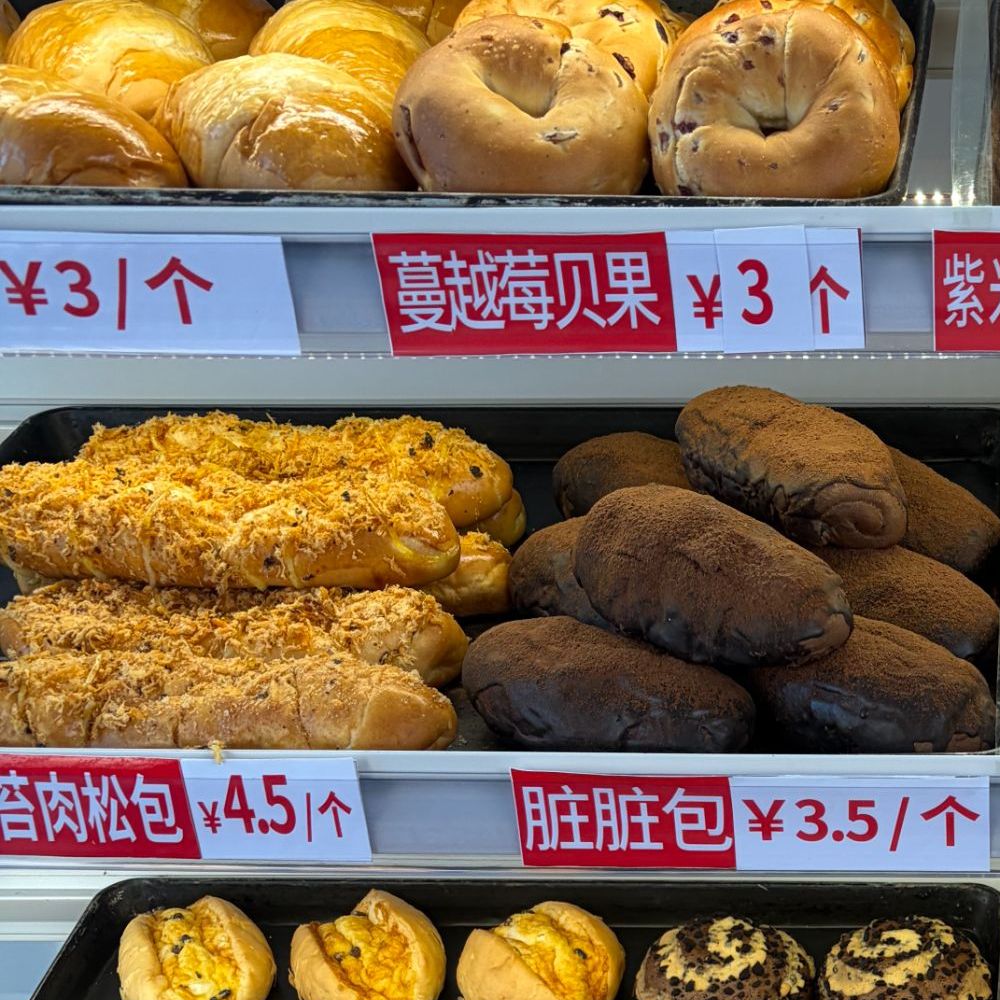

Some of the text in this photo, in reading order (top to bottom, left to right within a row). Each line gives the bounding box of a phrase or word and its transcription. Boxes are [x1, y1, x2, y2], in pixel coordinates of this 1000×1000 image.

[388, 250, 660, 332] 蔓越莓贝果
[521, 785, 733, 851] 脏脏包
